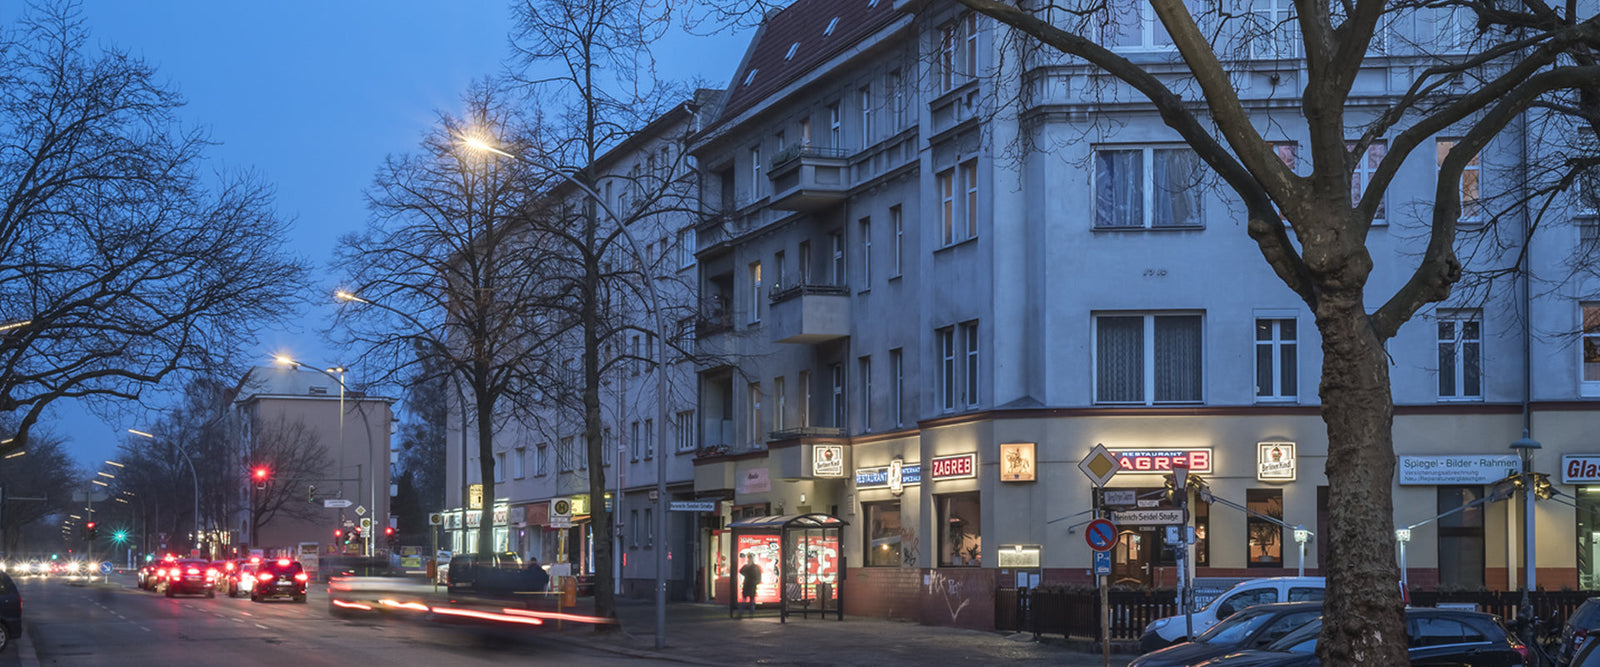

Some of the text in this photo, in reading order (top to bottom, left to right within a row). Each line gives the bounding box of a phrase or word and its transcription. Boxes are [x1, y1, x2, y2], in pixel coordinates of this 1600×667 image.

[933, 457, 971, 476] ZAGREB
[1109, 451, 1209, 470] AGREB
[1404, 458, 1517, 469] Spiegel Bilder Rahmen
[1097, 552, 1105, 562] P
